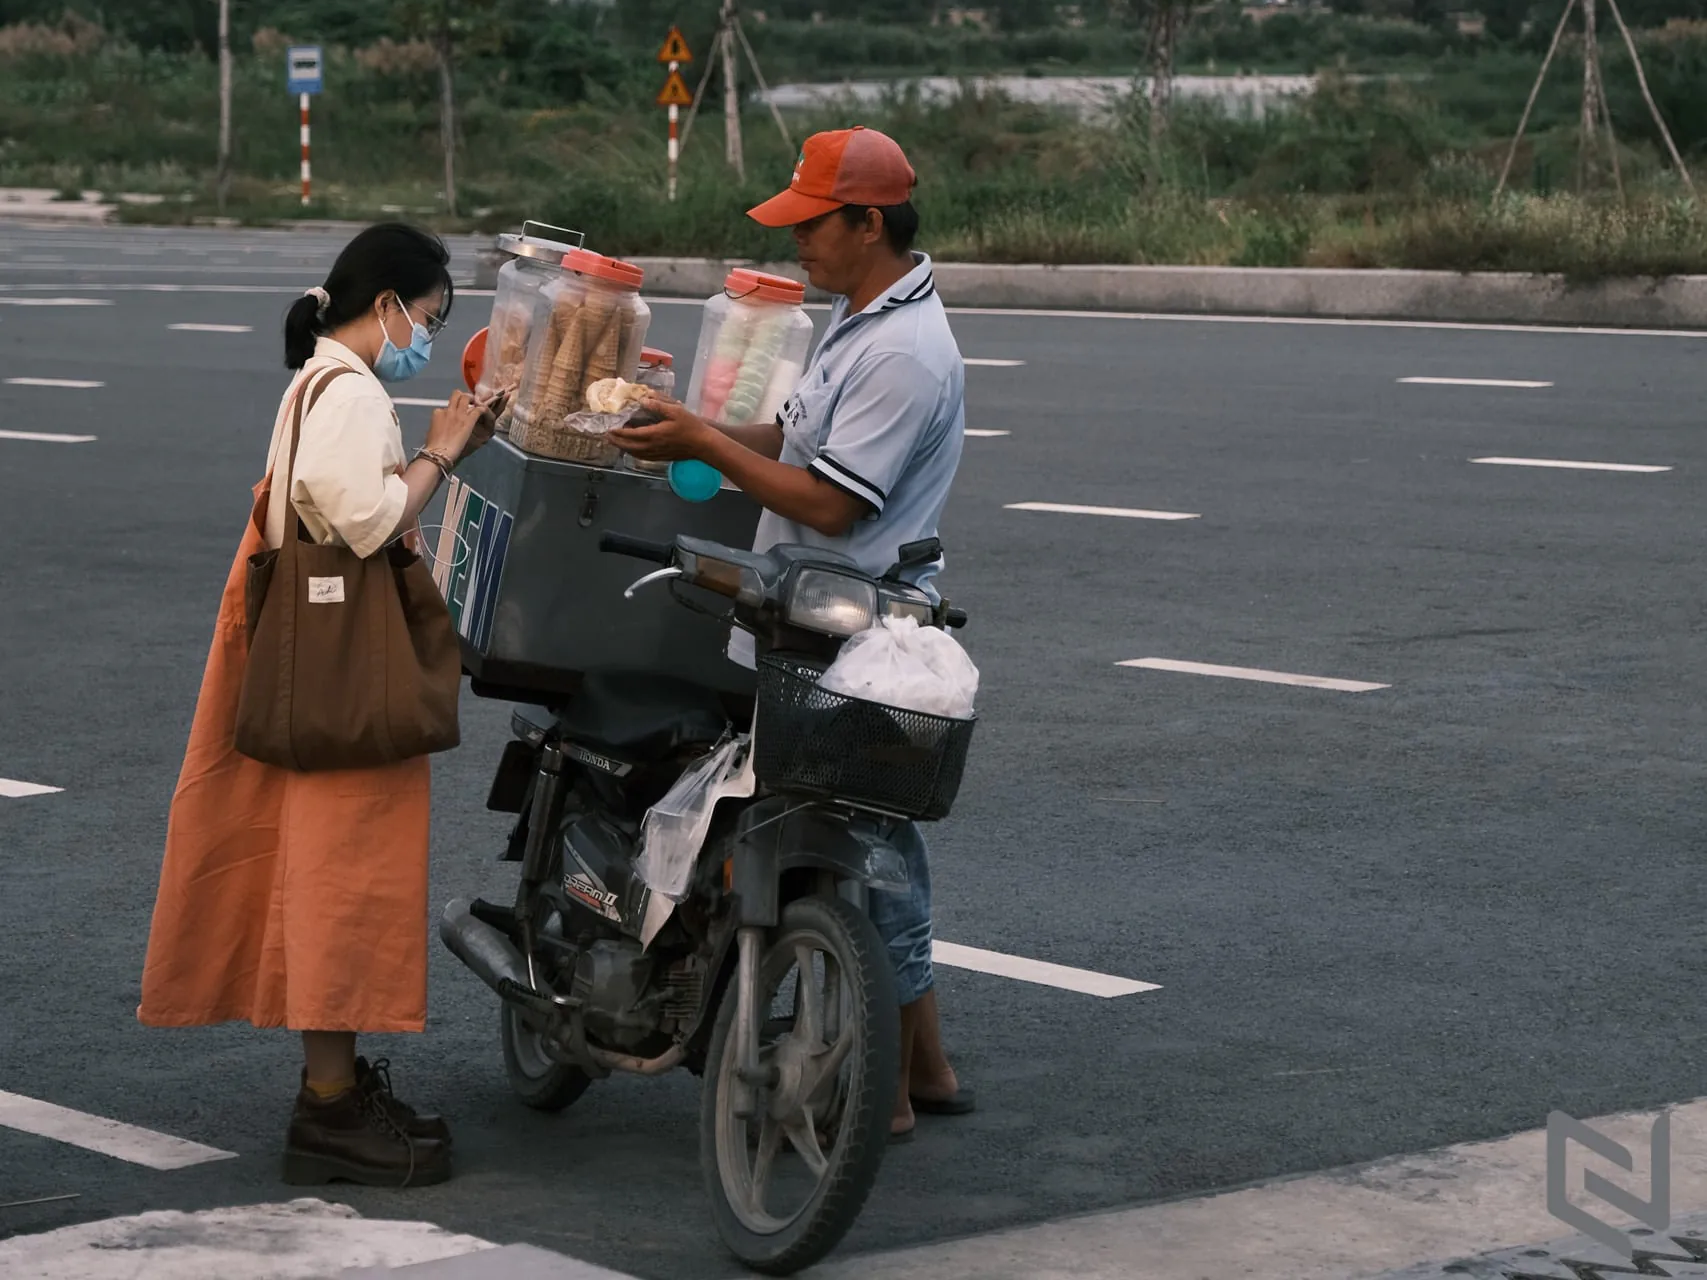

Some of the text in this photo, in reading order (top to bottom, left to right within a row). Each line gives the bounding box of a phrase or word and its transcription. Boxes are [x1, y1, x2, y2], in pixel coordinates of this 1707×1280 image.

[432, 474, 514, 656] KEM
[579, 750, 611, 771] HONDA
[563, 873, 604, 901] DREAM
